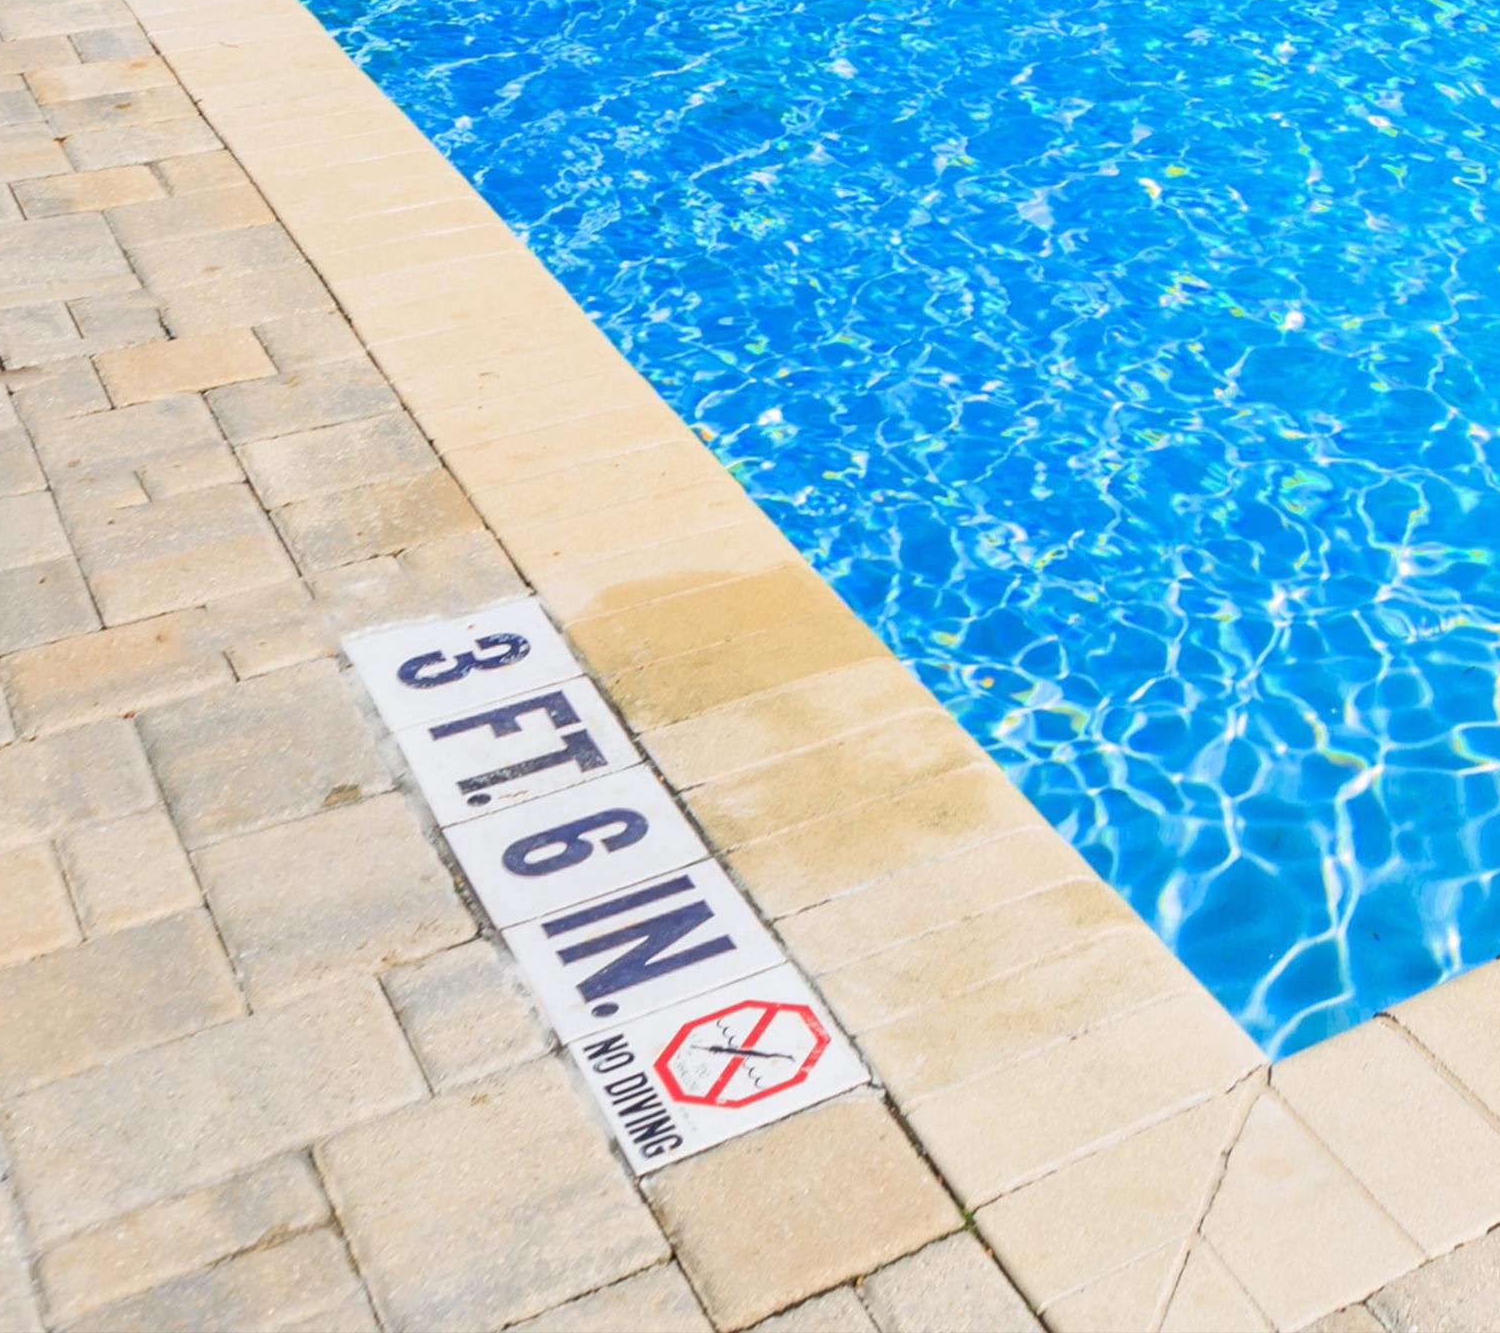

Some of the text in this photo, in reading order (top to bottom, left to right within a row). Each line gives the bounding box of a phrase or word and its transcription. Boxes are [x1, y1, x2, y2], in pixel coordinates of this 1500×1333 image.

[396, 632, 737, 1019] 3 FT. 6 IN.
[583, 1034, 684, 1159] NO DIVING
